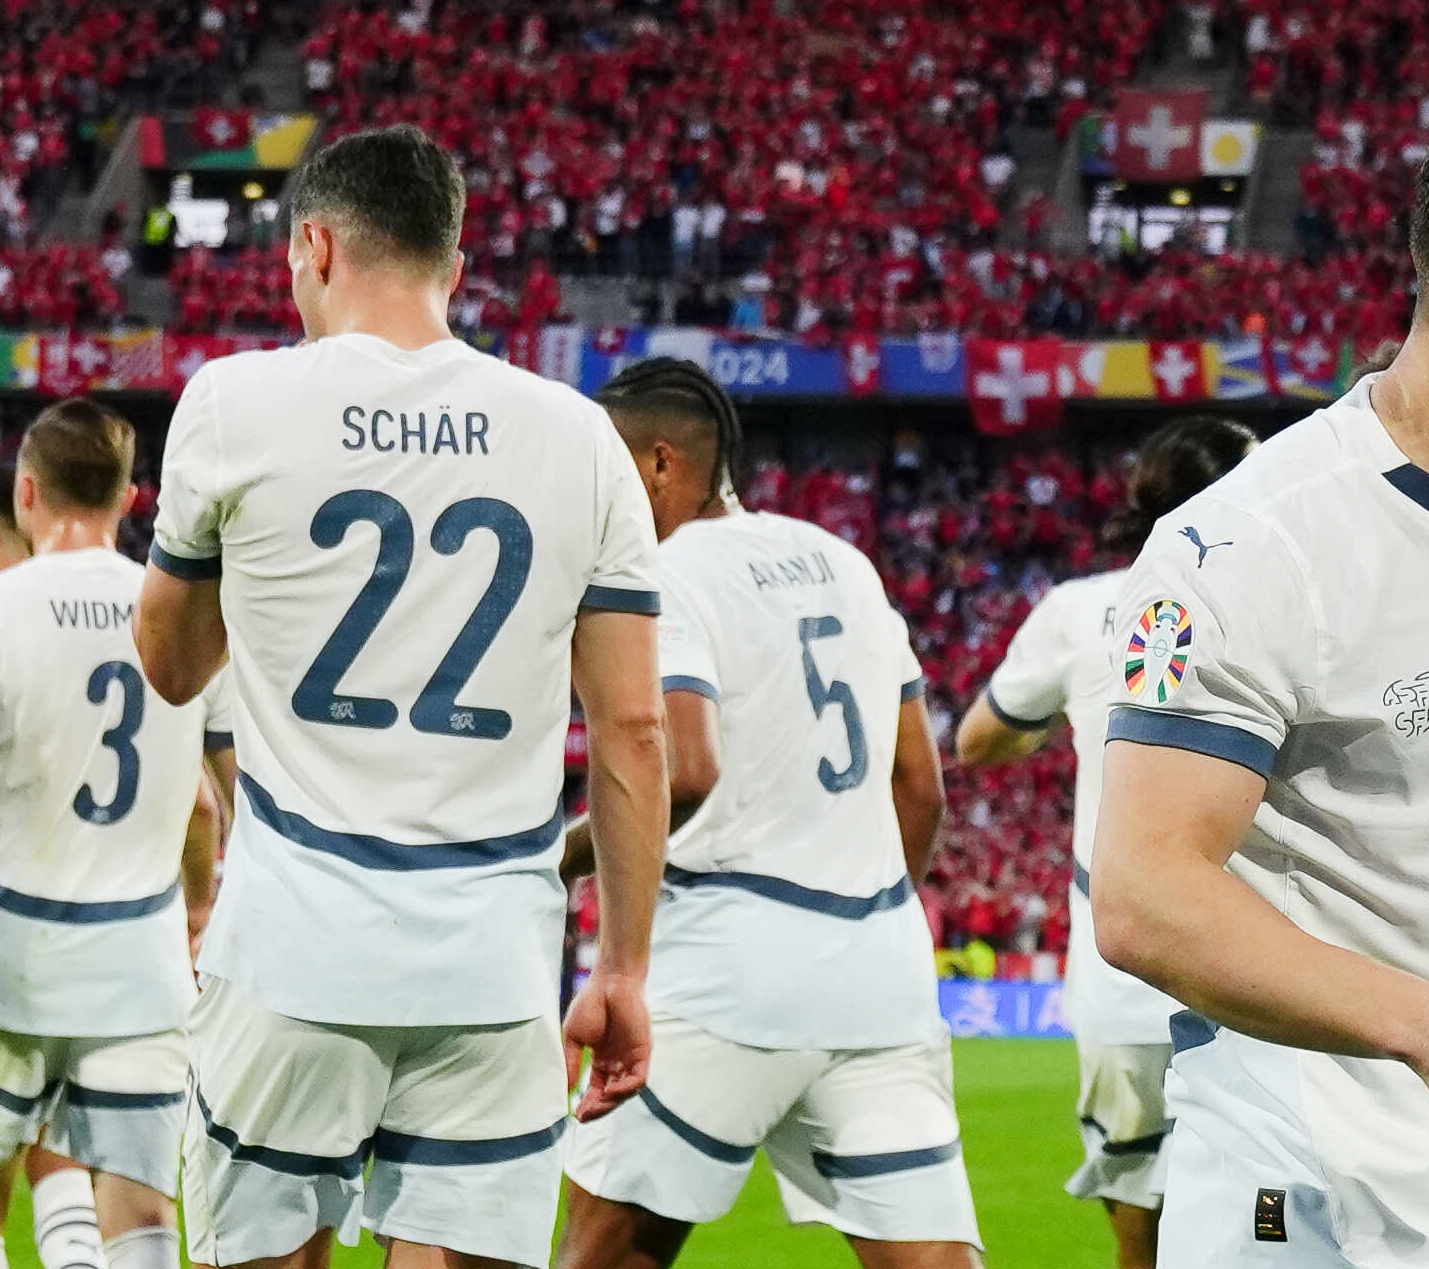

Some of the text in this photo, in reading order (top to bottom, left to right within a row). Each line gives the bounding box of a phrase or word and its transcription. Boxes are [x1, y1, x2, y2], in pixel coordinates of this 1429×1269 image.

[711, 347, 789, 385] 024
[341, 405, 490, 456] SCHÄR
[50, 599, 134, 630] WIDM
[291, 489, 534, 741] 22
[73, 661, 145, 825] 3
[798, 615, 869, 794] 5
